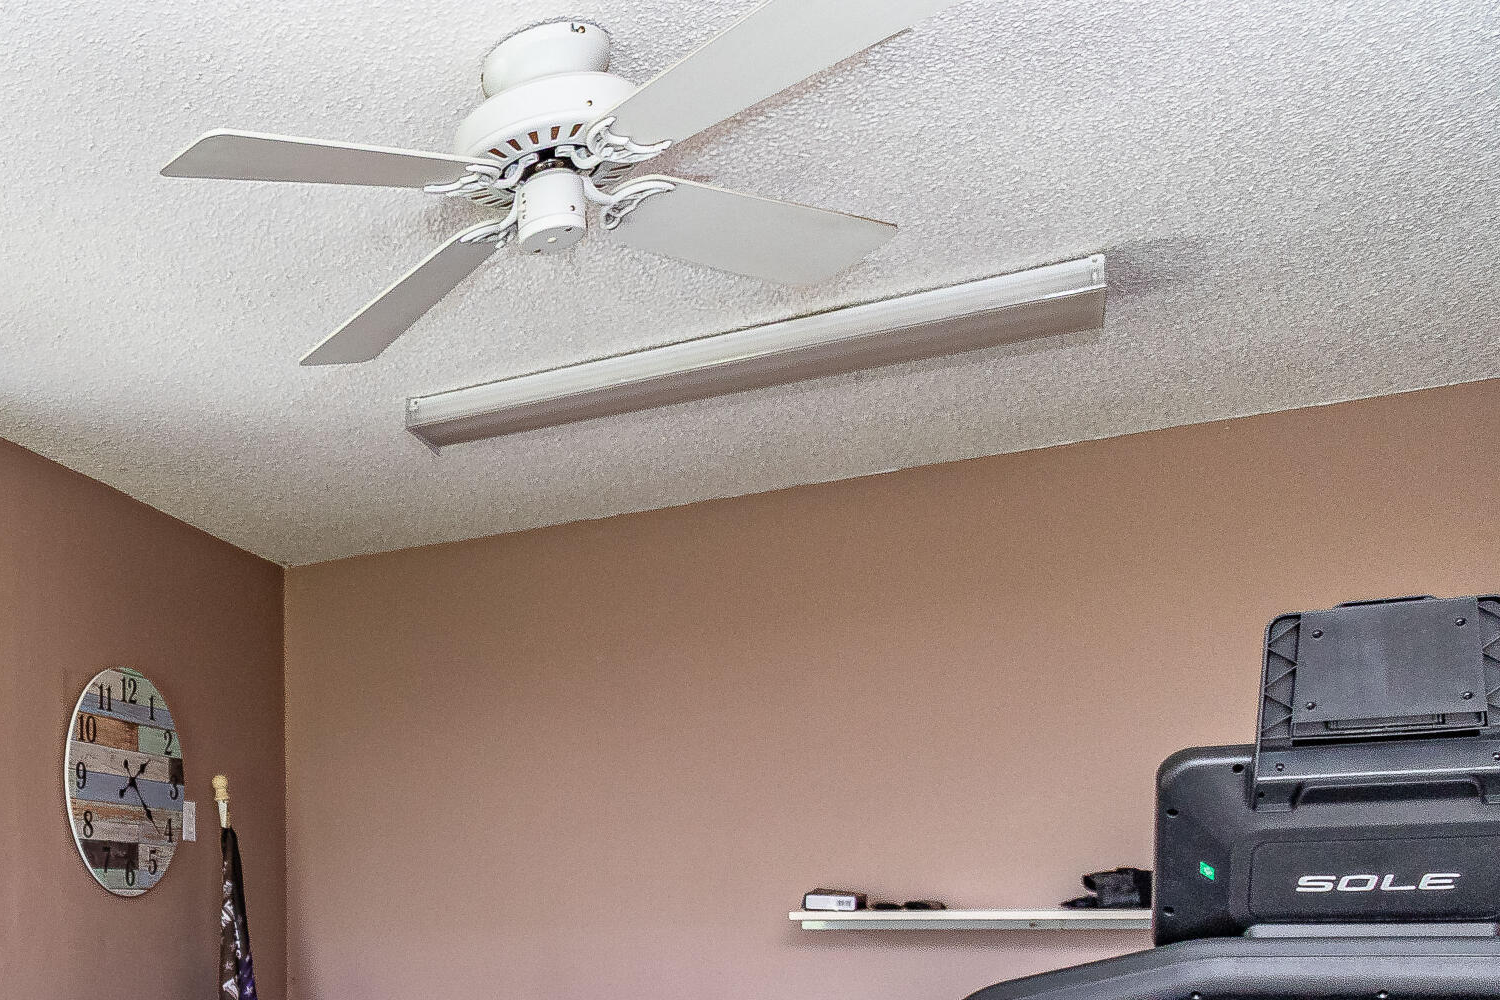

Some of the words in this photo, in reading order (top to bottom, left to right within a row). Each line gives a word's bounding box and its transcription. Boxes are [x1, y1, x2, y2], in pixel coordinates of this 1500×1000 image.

[99, 683, 112, 712] 11
[120, 676, 137, 704] 12
[149, 695, 156, 721] 1
[77, 714, 97, 743] 10
[164, 729, 173, 755] 2
[76, 761, 87, 789] 9
[169, 774, 180, 800] 3
[83, 810, 94, 838] 8
[163, 817, 174, 843] 4
[102, 845, 112, 873] 7
[125, 857, 136, 886] 6
[148, 850, 158, 875] 5
[1296, 873, 1461, 892] SOLE
